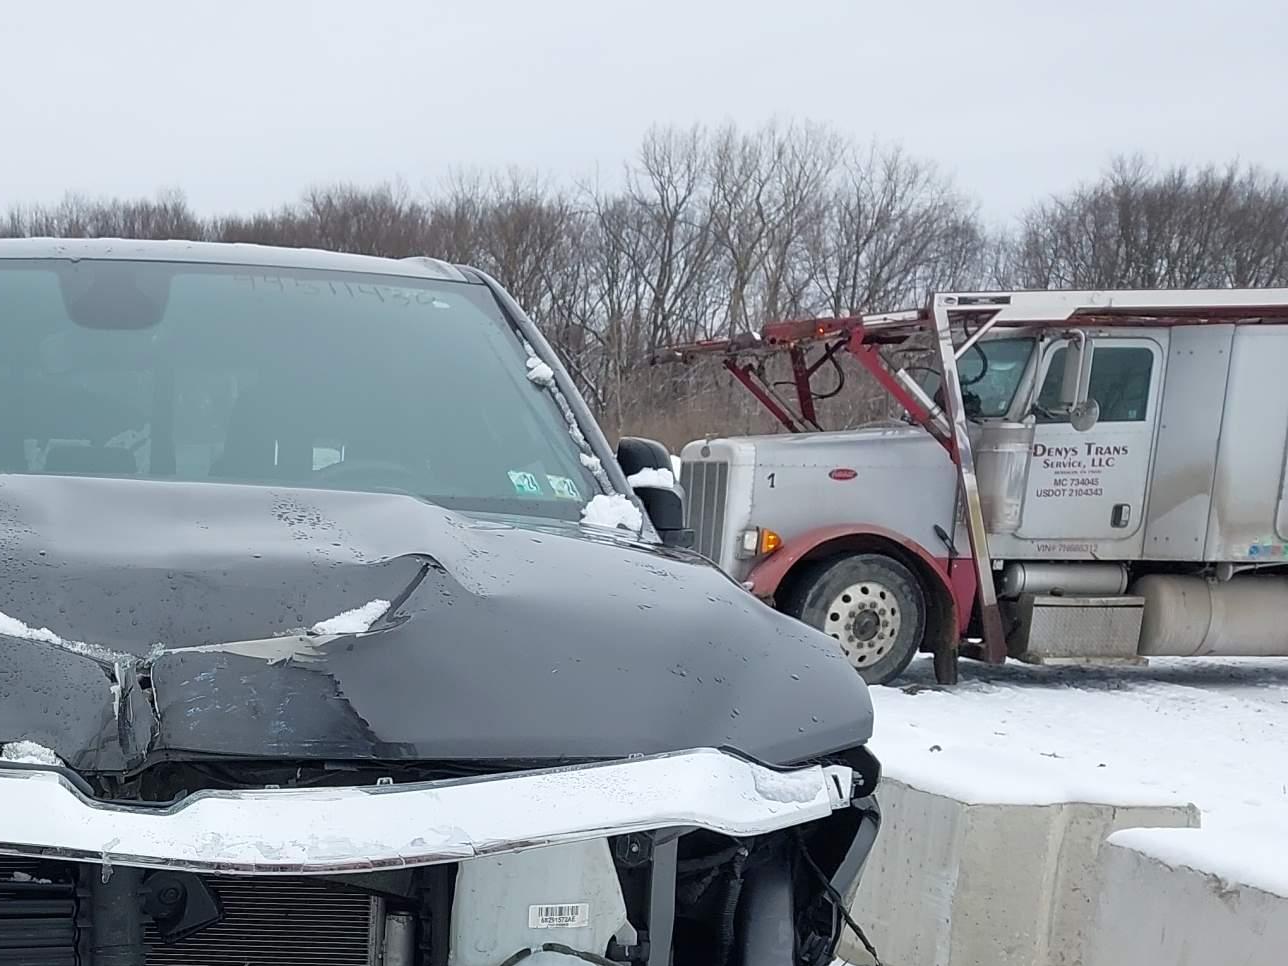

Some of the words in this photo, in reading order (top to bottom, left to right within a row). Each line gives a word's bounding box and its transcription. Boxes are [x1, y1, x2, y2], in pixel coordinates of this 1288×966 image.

[1091, 457, 1115, 467] LLC
[767, 472, 776, 488] 1
[1053, 478, 1068, 487] MC
[1069, 478, 1100, 486] 734045
[1036, 489, 1066, 497] USDOT
[1068, 488, 1103, 496] 2104343
